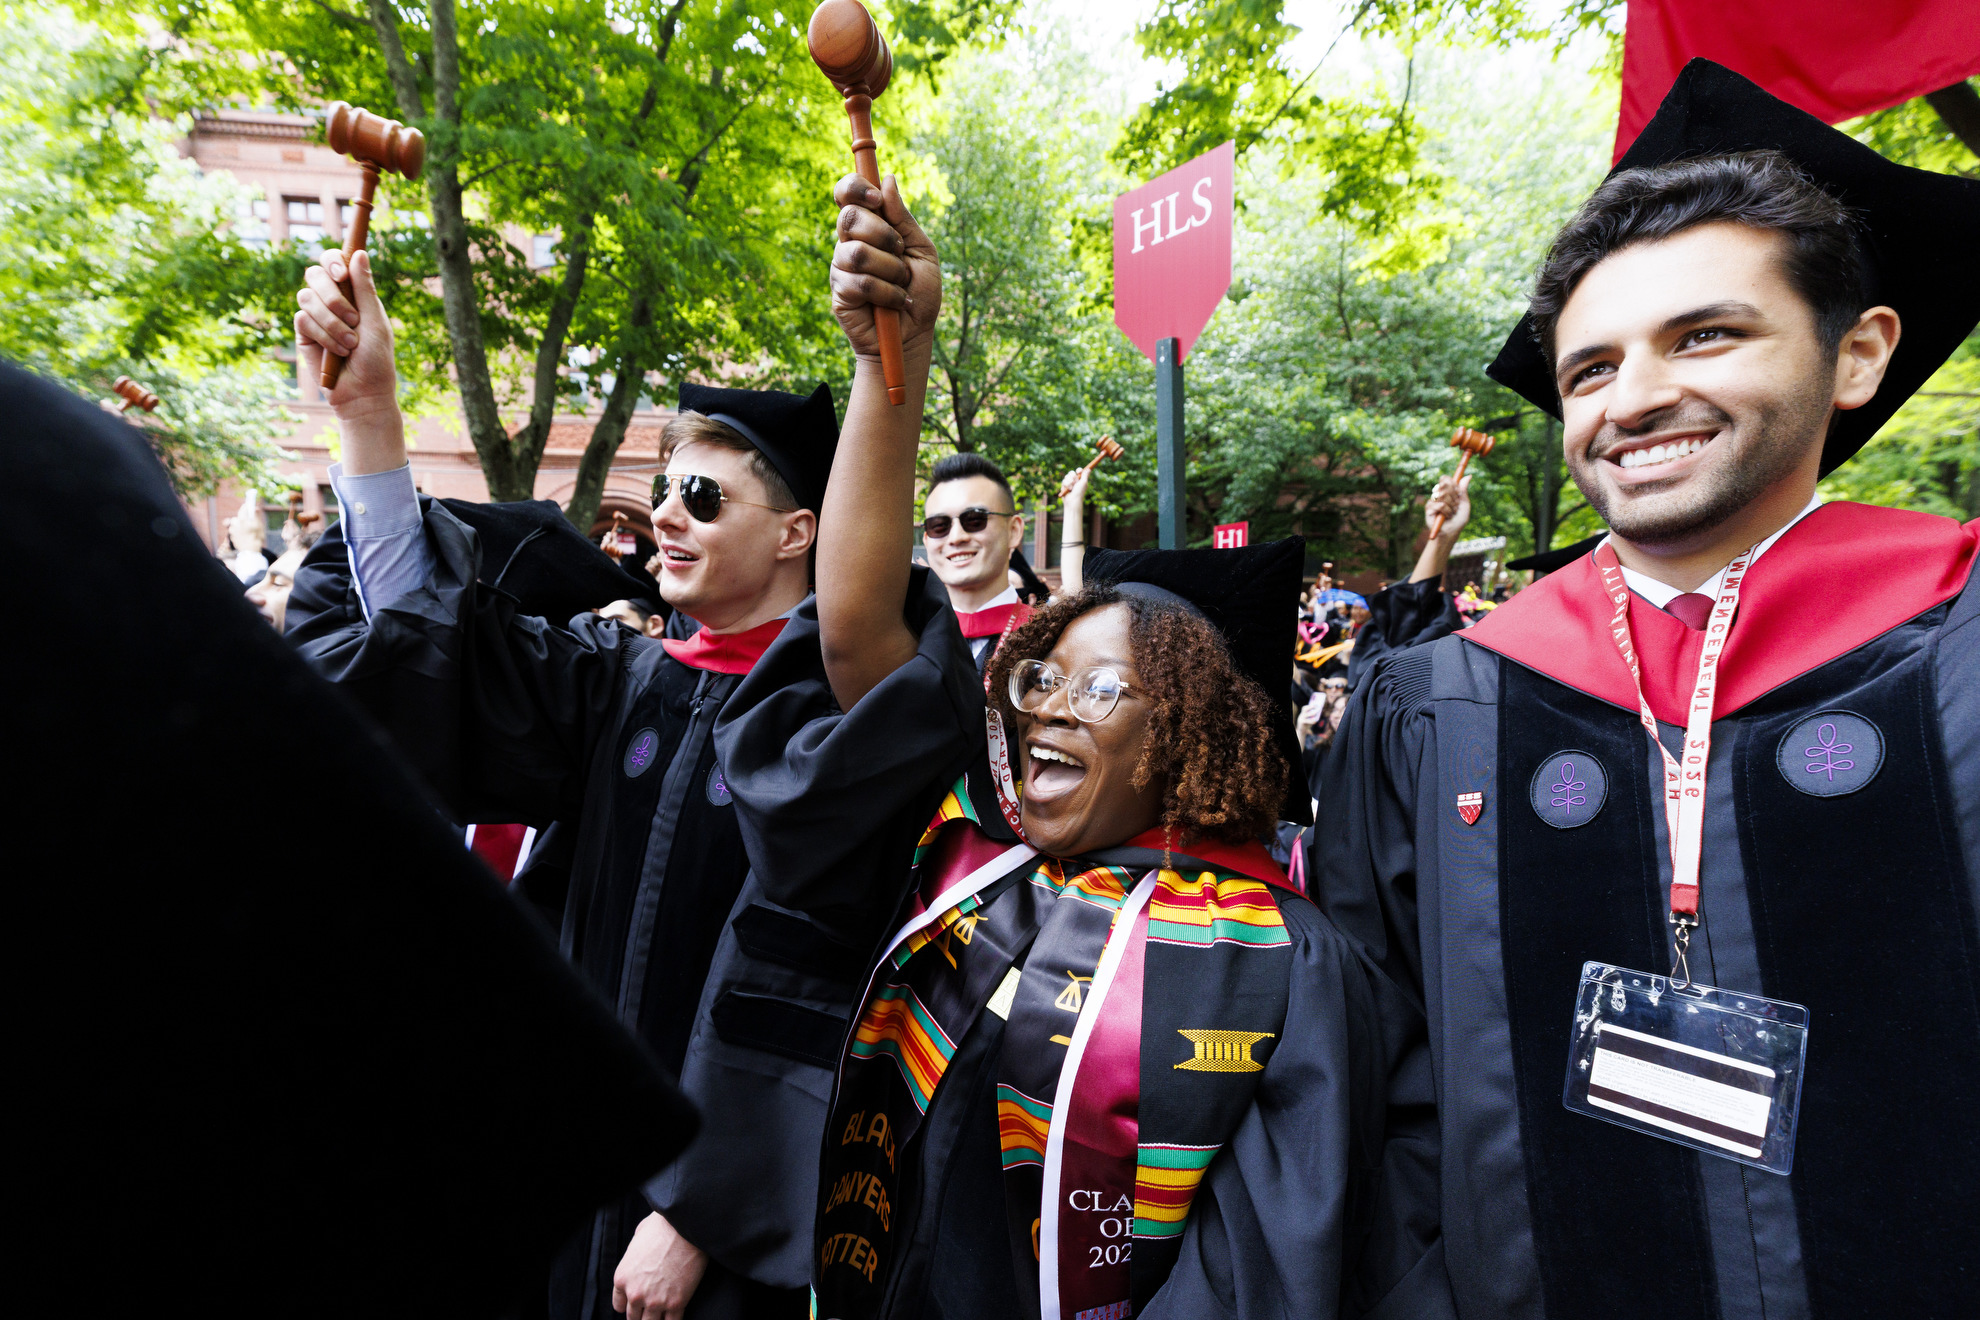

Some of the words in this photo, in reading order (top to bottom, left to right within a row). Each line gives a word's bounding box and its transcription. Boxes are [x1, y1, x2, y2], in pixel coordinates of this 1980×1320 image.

[1130, 176, 1212, 254] HLS
[842, 1110, 895, 1174] BLACK
[825, 1171, 890, 1232] LAWYERS
